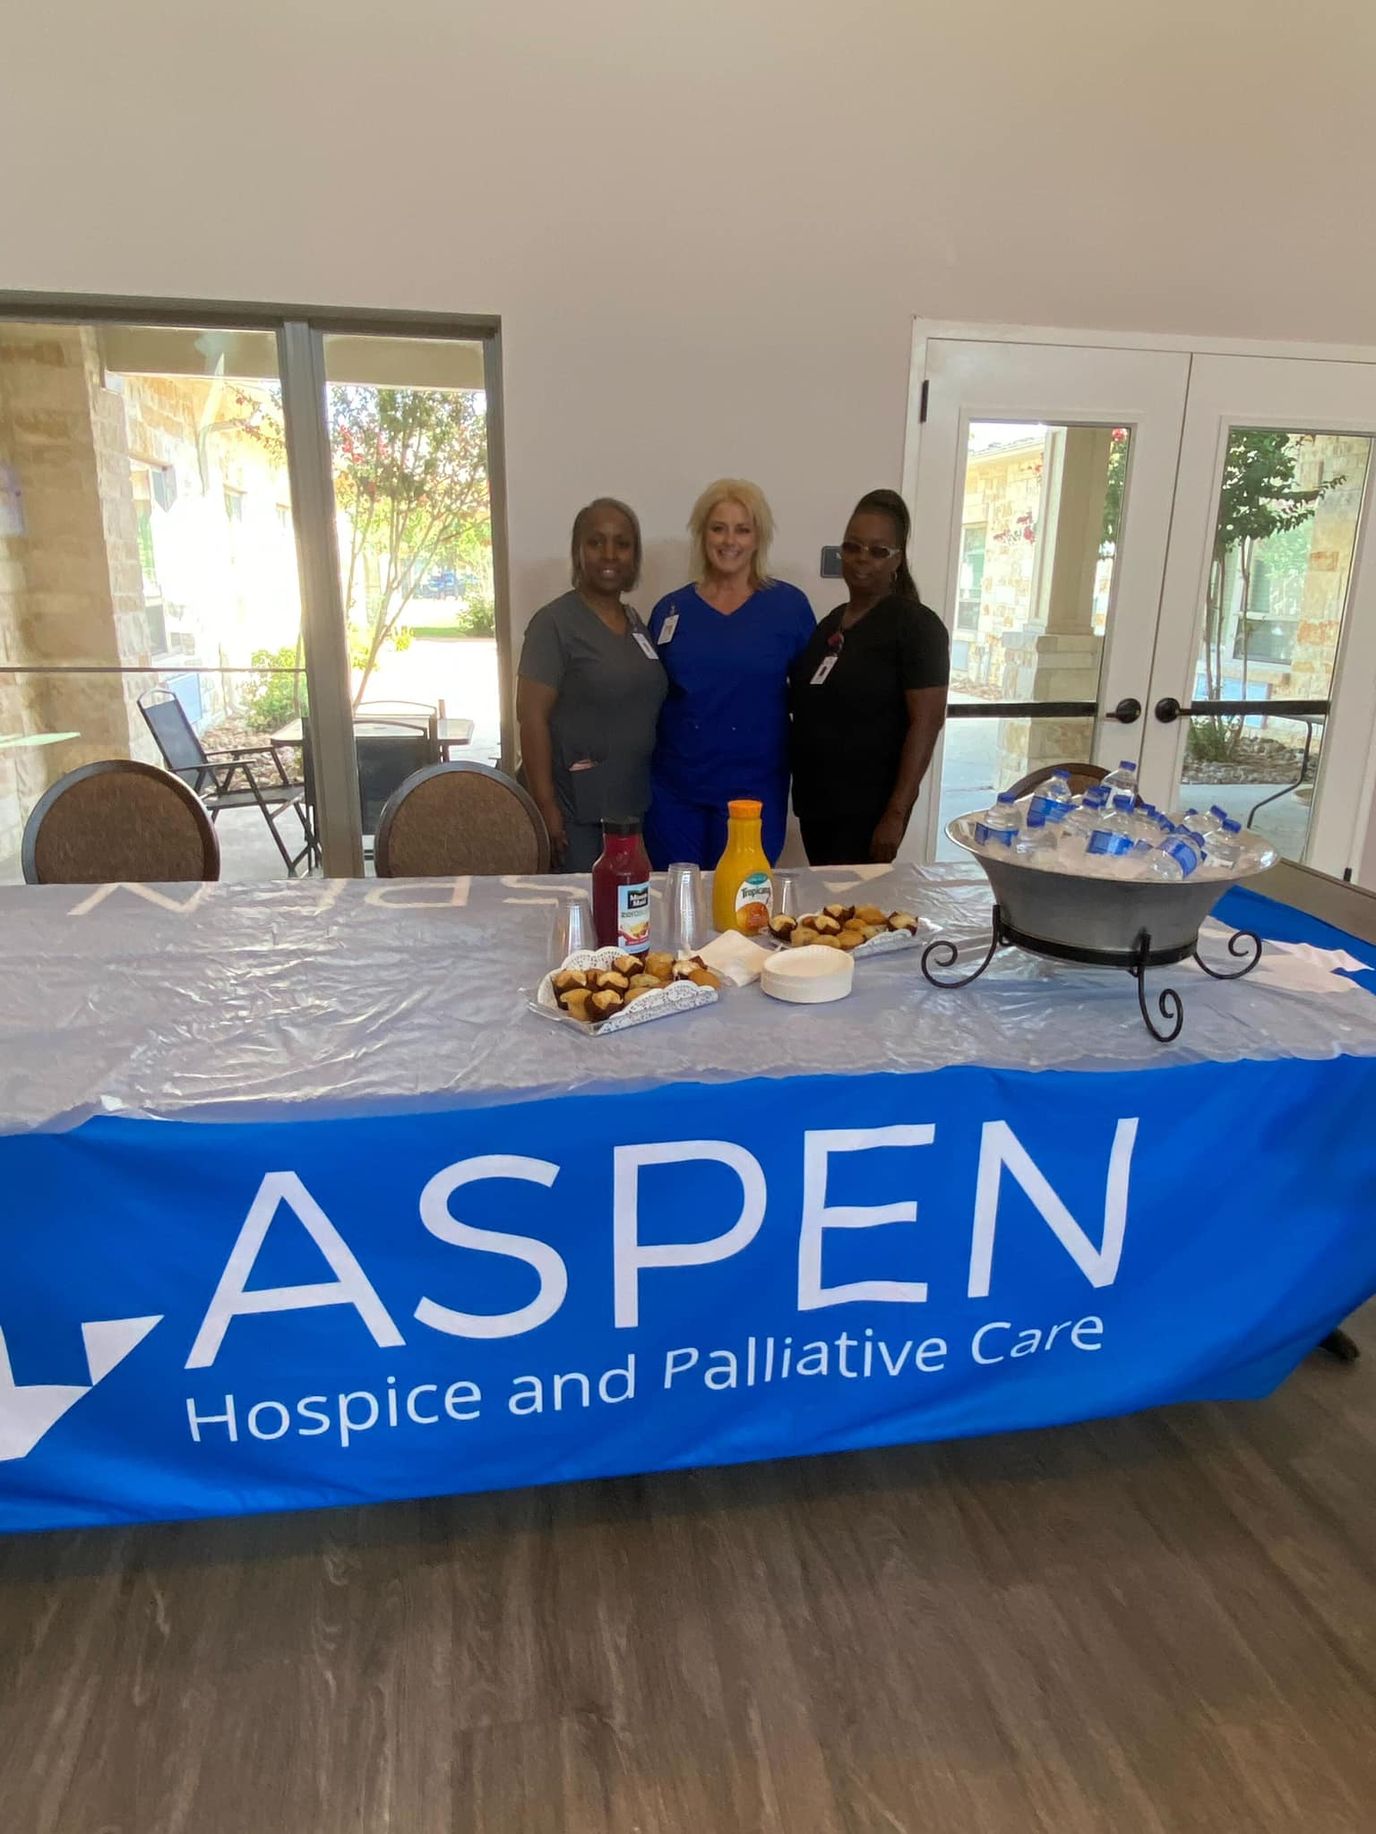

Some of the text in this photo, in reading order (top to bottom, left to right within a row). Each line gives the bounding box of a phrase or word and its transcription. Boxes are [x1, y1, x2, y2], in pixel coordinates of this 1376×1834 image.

[184, 1117, 1139, 1369] ASPEN
[186, 1316, 1104, 1447] Hospice and Palliative Care
